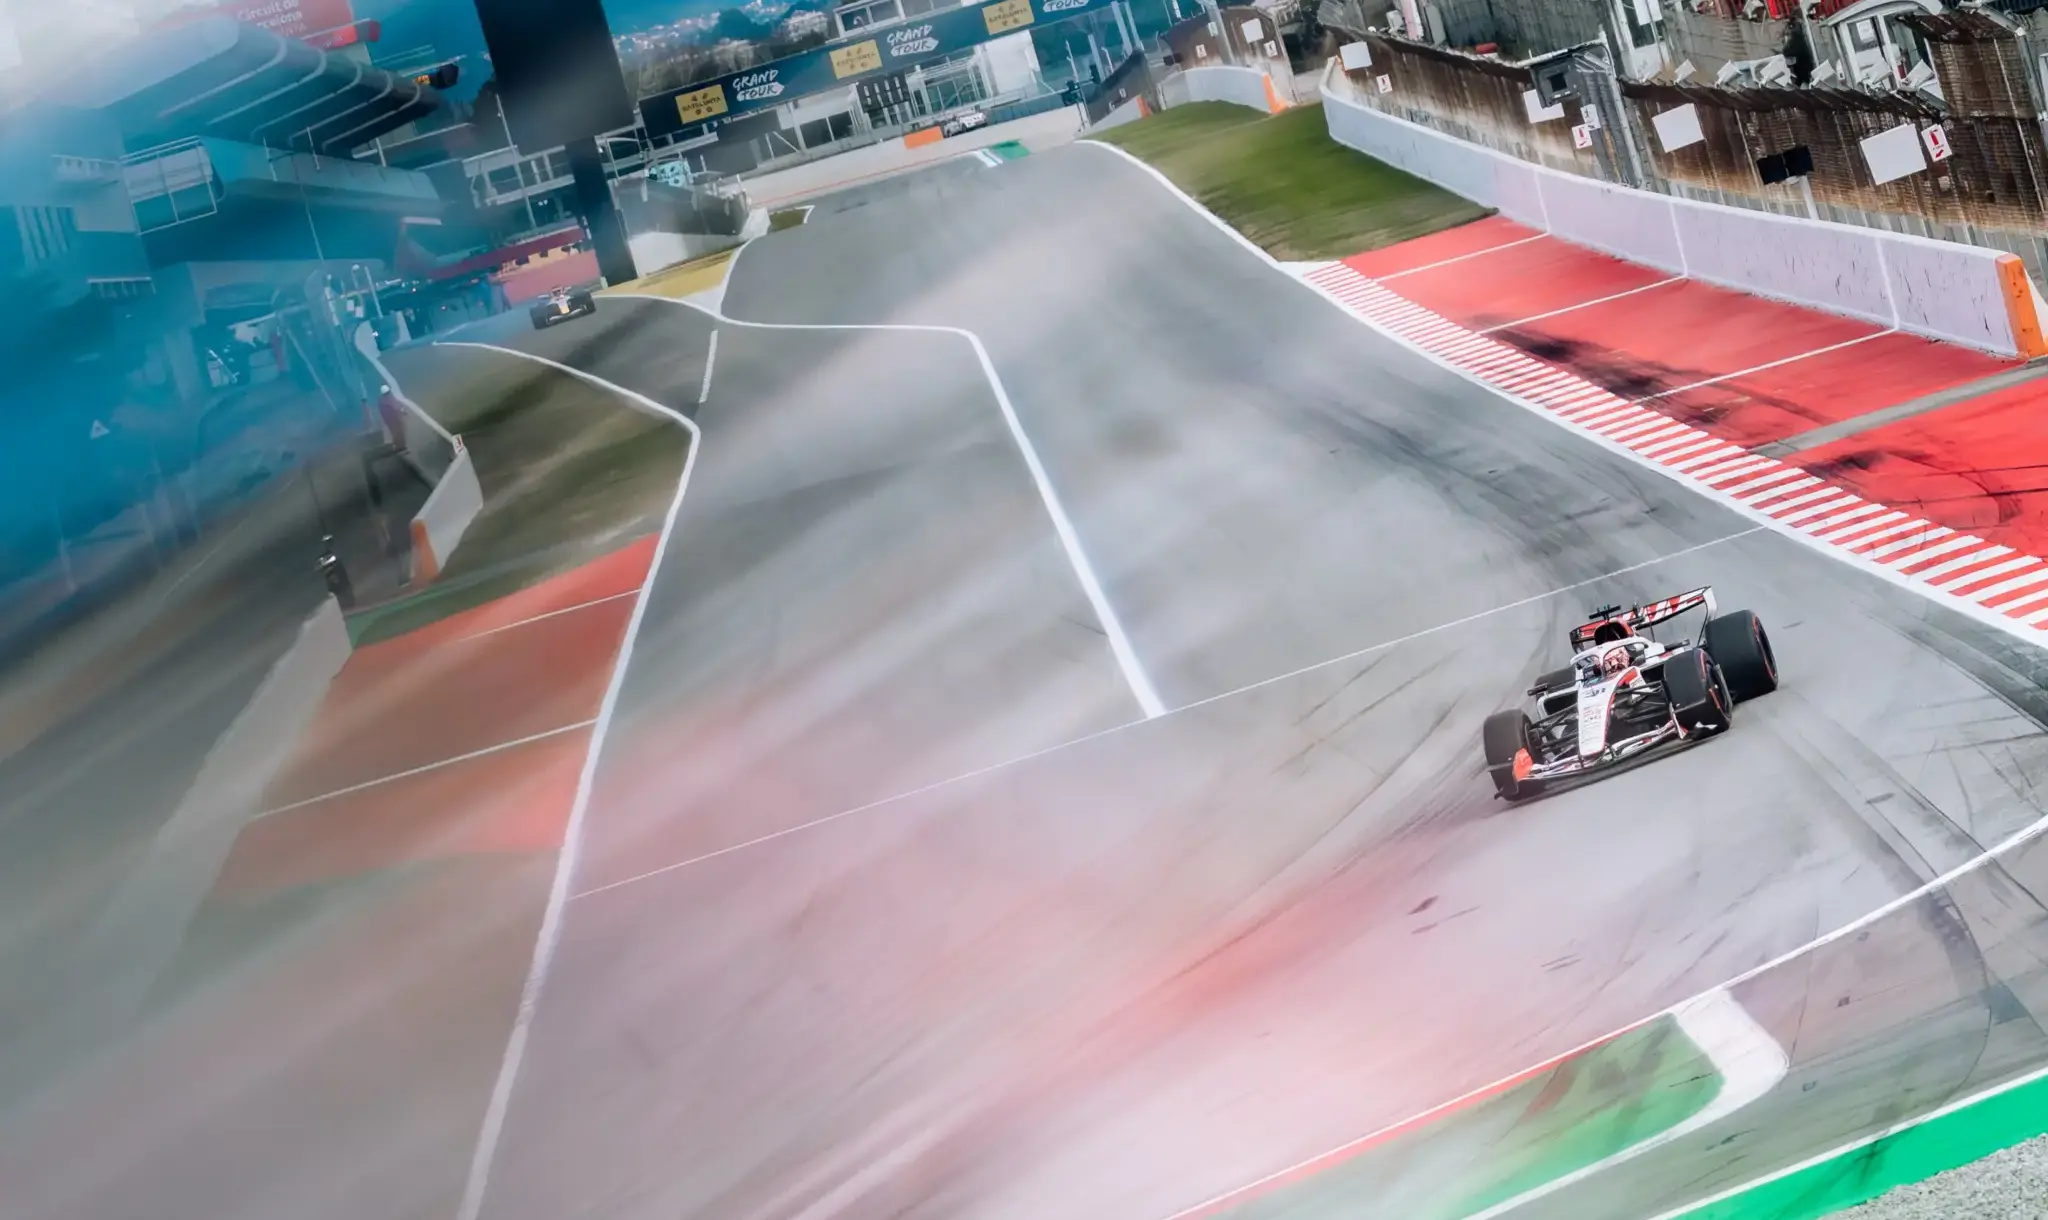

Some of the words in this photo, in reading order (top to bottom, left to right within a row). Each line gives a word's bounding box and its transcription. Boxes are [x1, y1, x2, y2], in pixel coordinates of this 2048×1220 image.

[236, 2, 283, 21] Circuit
[256, 11, 304, 29] rcelona
[887, 24, 933, 46] GRAND
[894, 38, 932, 52] TOUR
[733, 70, 779, 91] GRAND
[740, 83, 778, 98] TOUR
